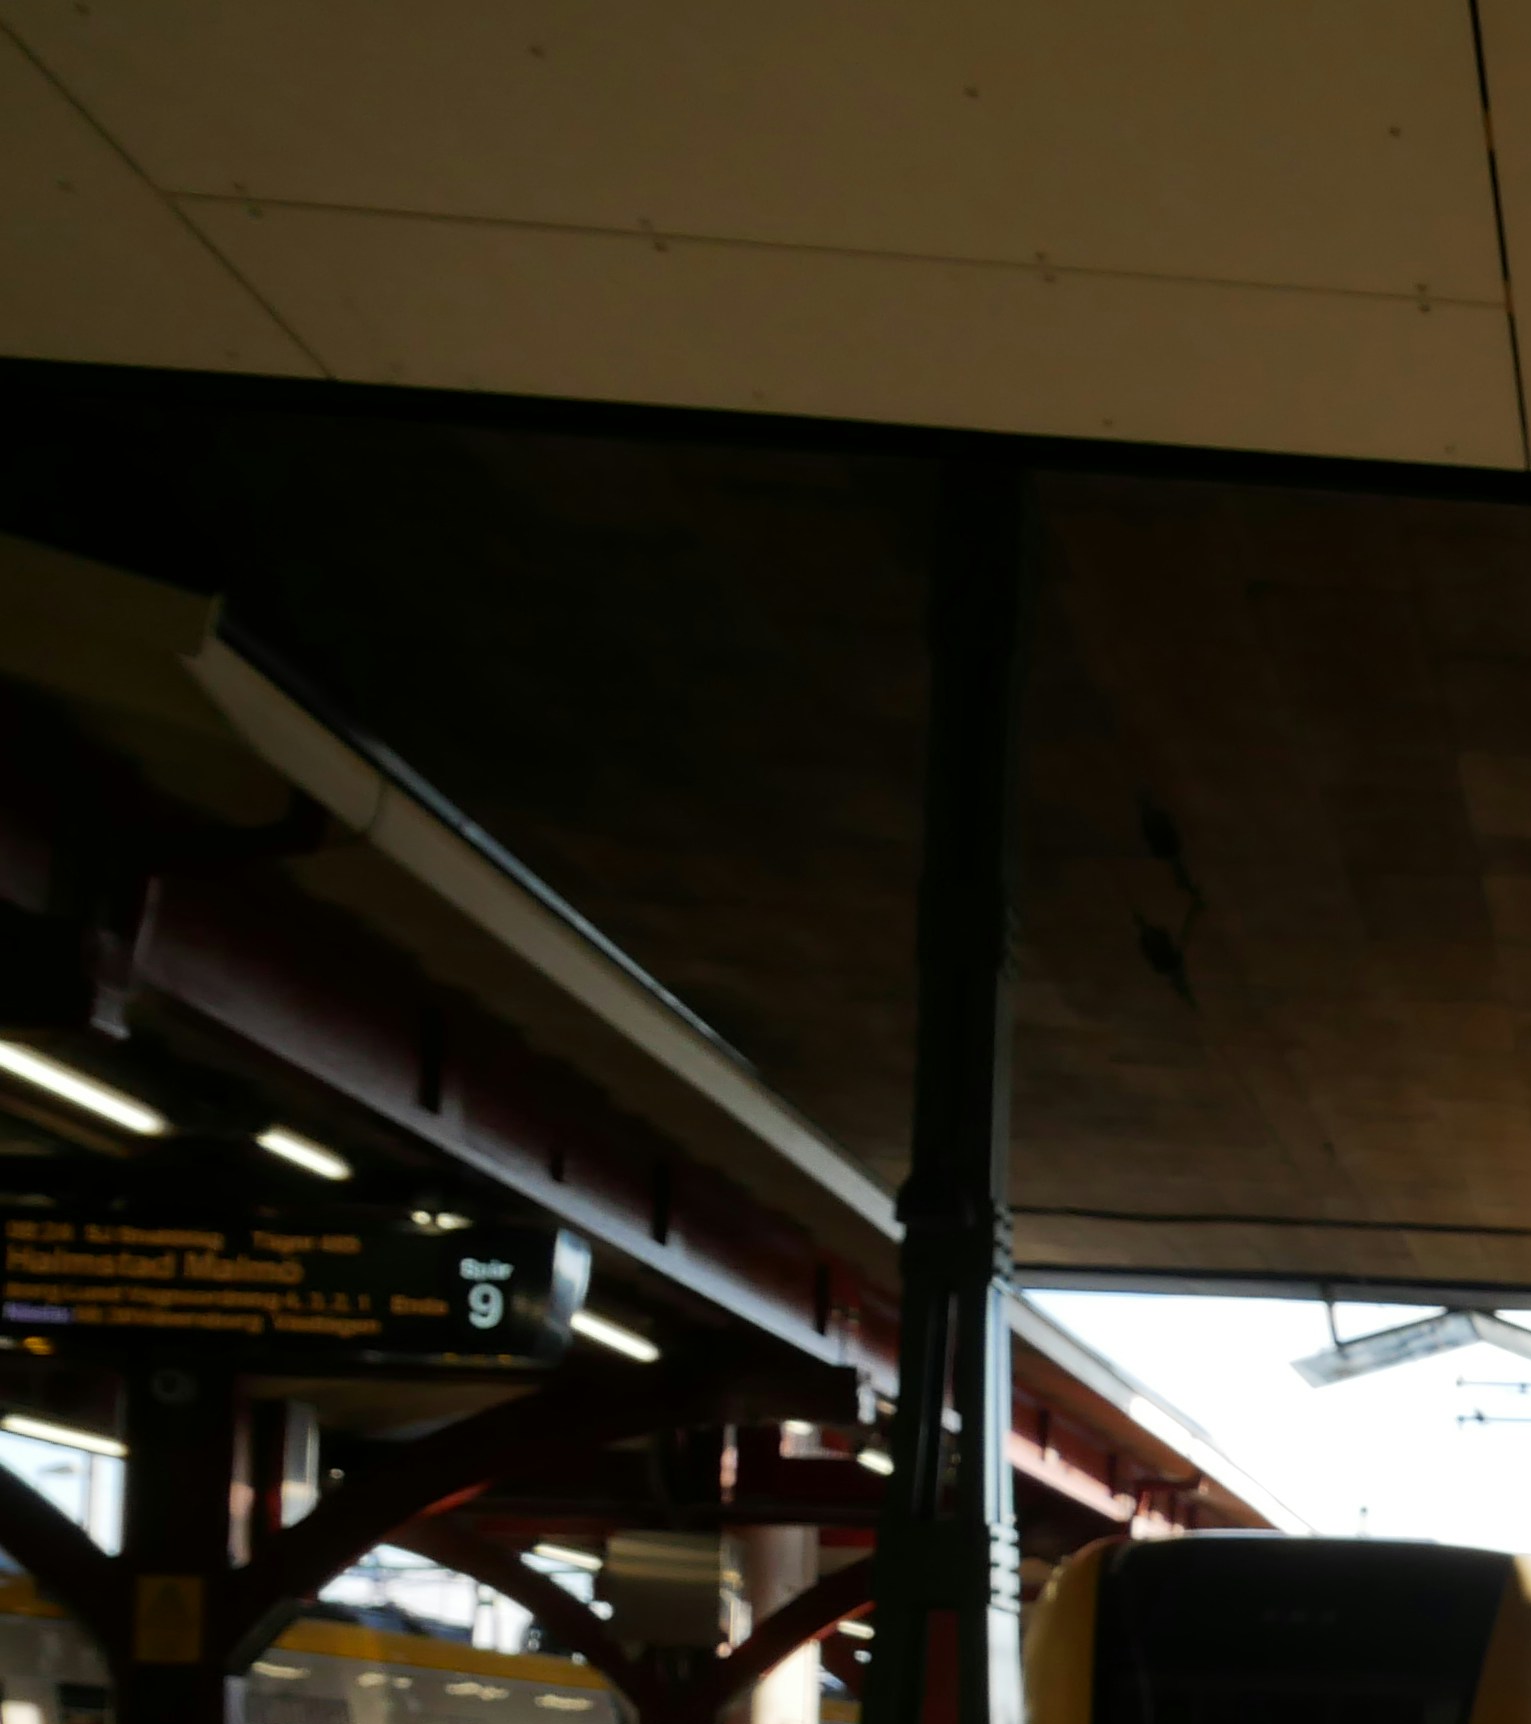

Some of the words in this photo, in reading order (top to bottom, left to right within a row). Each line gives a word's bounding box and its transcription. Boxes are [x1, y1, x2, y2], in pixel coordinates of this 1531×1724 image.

[6, 1244, 177, 1279] Halmstad
[183, 1250, 305, 1286] Malmö
[459, 1257, 516, 1281] Spår
[468, 1282, 504, 1330] 9
